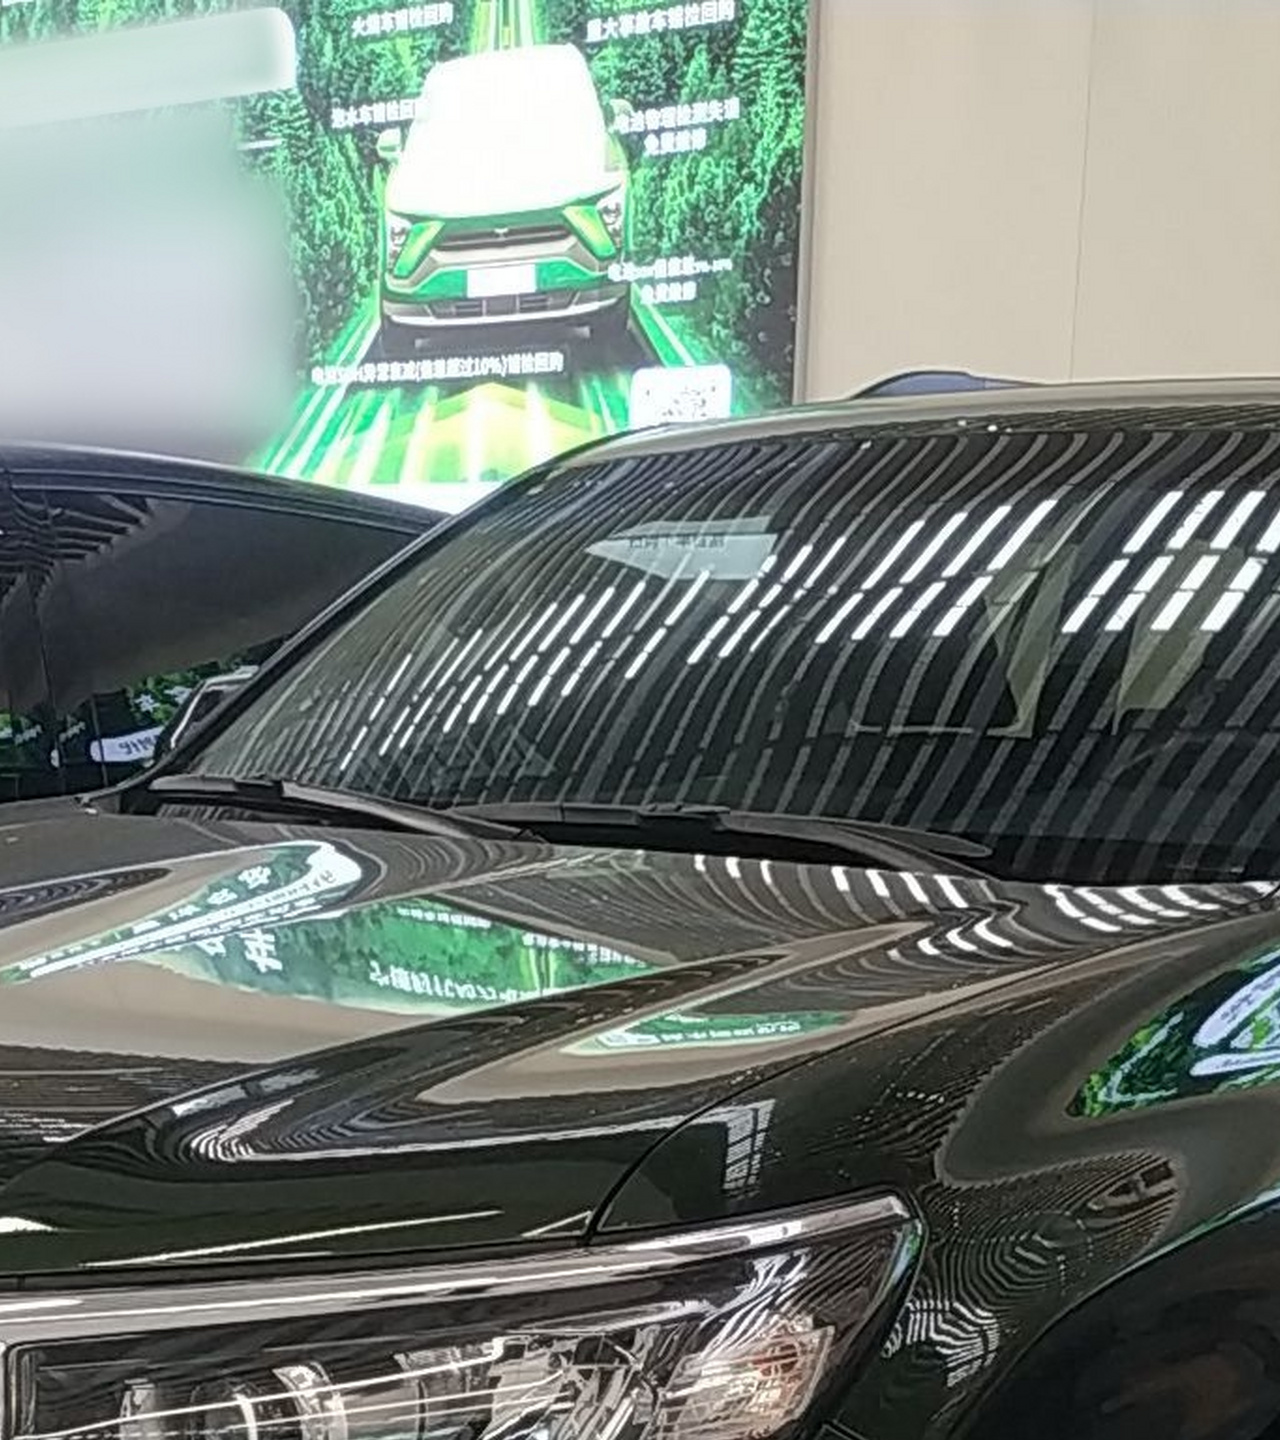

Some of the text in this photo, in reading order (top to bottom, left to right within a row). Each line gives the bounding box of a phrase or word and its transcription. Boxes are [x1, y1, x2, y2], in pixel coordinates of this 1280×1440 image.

[331, 99, 429, 130] 泡水车错检回
